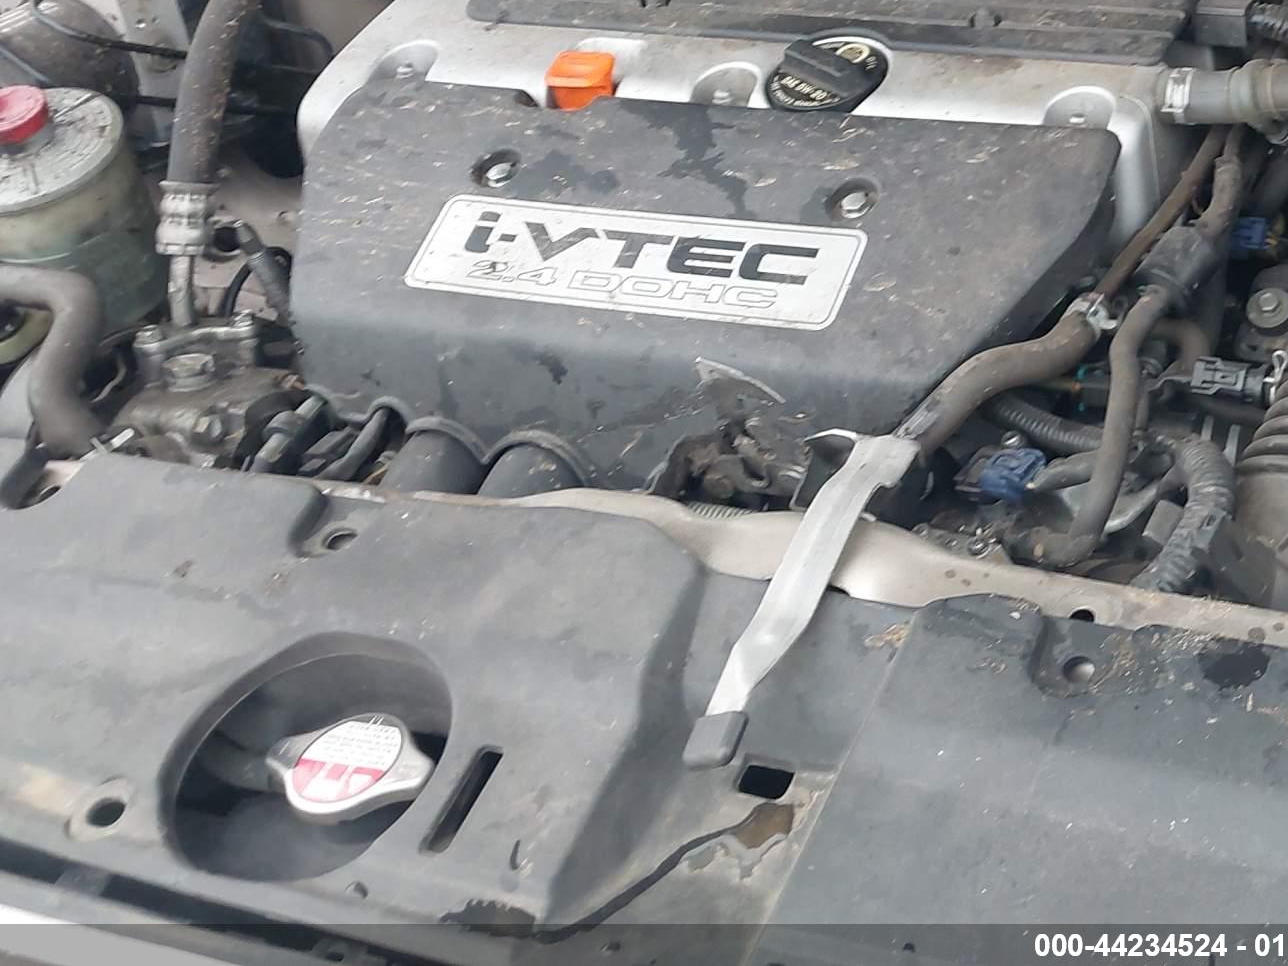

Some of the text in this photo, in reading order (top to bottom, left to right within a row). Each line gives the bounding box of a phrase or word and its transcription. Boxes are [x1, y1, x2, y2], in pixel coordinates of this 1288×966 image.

[465, 211, 819, 285] i-VTEC
[466, 259, 780, 309] 2.4 DOHC
